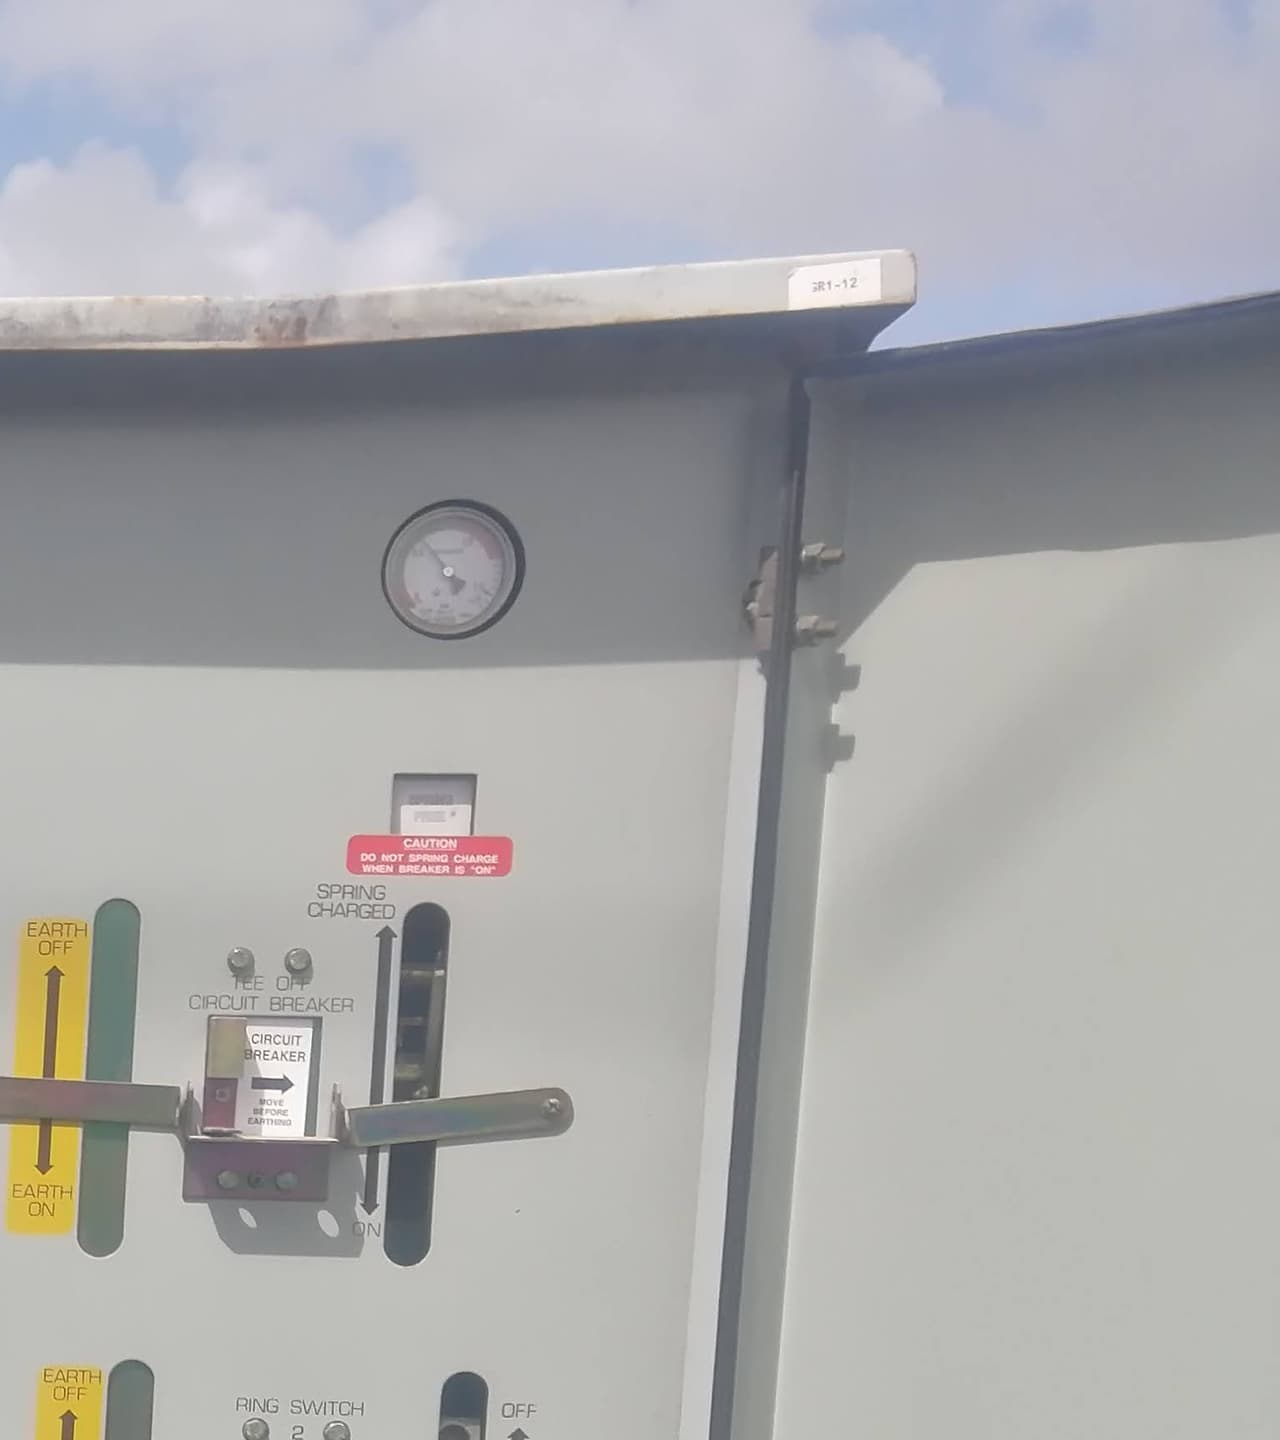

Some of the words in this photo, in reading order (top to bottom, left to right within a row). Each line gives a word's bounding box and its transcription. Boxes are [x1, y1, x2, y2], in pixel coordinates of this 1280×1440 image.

[403, 838, 457, 849] CAUTION
[360, 853, 377, 862] DO
[381, 853, 404, 862] NOT
[408, 854, 448, 863] SPRING
[453, 854, 499, 864] CHARGE
[362, 865, 394, 874] WHEN
[398, 865, 450, 874] BREAKER
[455, 866, 465, 875] IS
[471, 866, 496, 875] "ON"
[316, 883, 387, 901] SPRING
[307, 902, 397, 920] CHARGED
[26, 922, 89, 939] EARTH
[37, 940, 74, 956] OFF
[231, 975, 265, 991] TEE
[276, 975, 311, 992] OFF
[188, 994, 259, 1011] CIRCUIT
[269, 996, 355, 1013] BREAKER
[251, 1033, 303, 1047] CIRCUIT
[244, 1049, 307, 1063] BREAKER
[258, 1097, 285, 1107] MOVE
[252, 1107, 289, 1117] BEFORE
[247, 1117, 292, 1127] EARTHING
[11, 1184, 74, 1200] EARTH
[27, 1200, 56, 1218] ON
[351, 1221, 382, 1239] ON
[42, 1368, 102, 1385] EARTH
[52, 1385, 88, 1401] OFF
[235, 1397, 280, 1414] RING
[290, 1399, 365, 1416] SWITCH
[501, 1403, 537, 1419] OFF
[291, 1425, 305, 1440] 2
